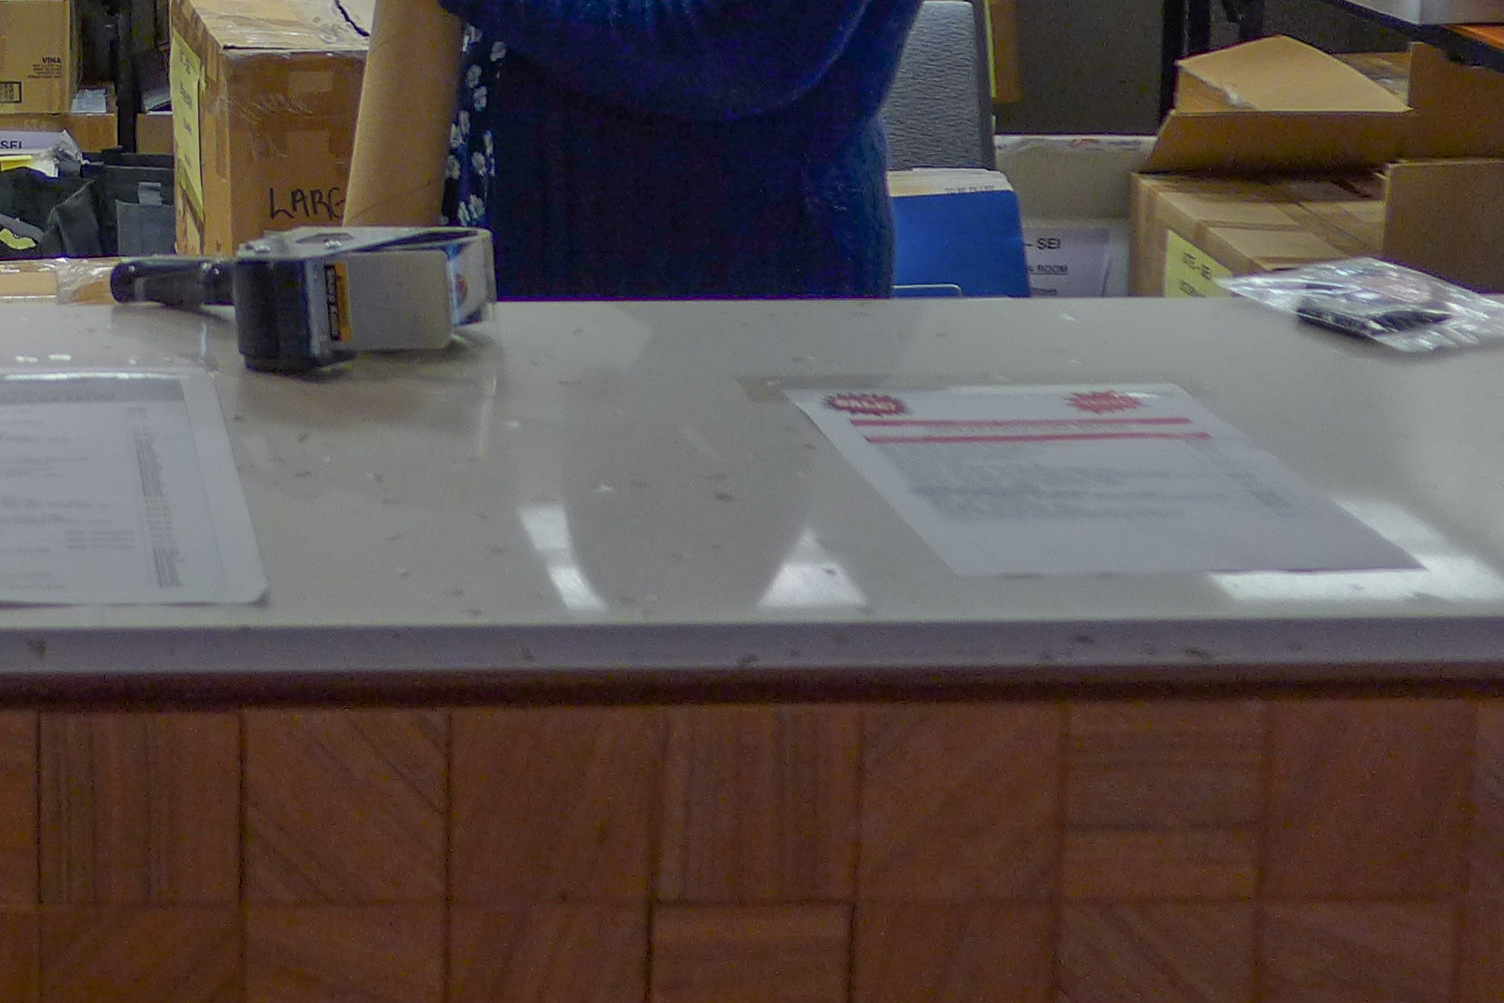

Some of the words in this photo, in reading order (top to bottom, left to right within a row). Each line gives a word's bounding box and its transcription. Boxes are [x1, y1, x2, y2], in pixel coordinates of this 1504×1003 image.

[269, 187, 346, 220] LARG
[1036, 238, 1061, 249] SEI
[1037, 264, 1068, 274] ROOM
